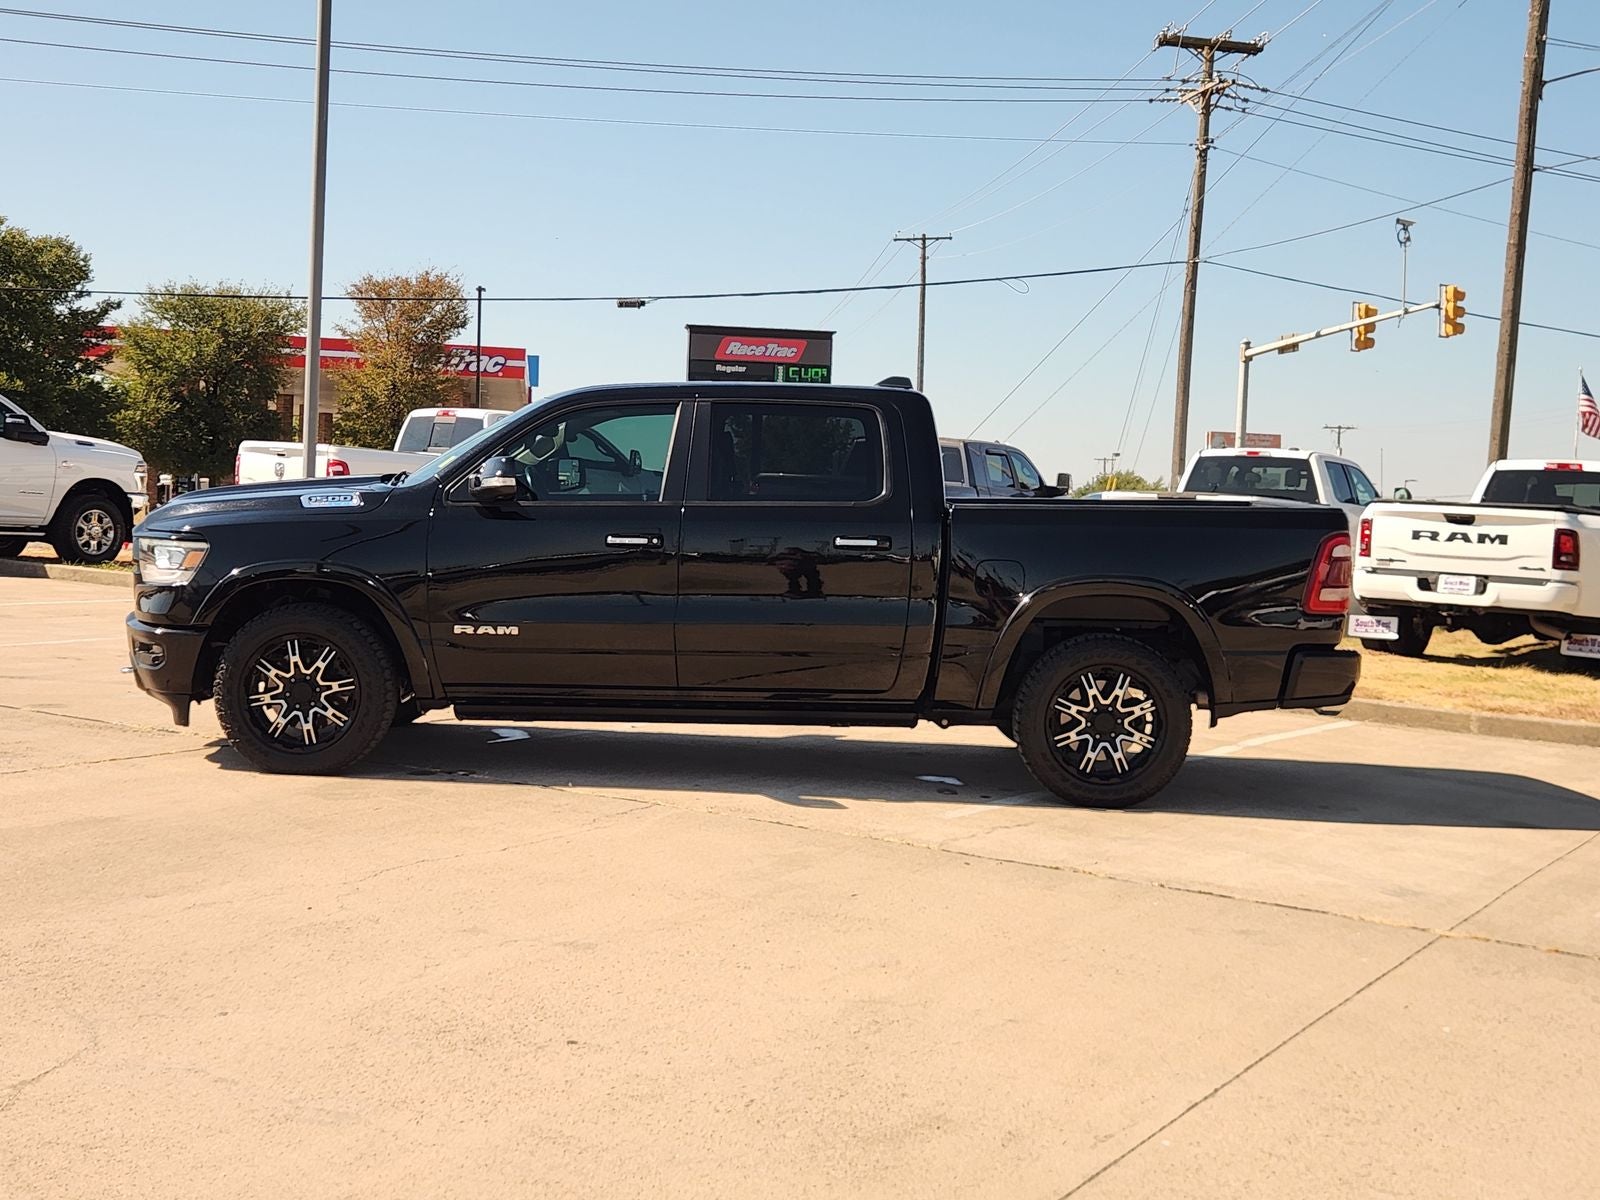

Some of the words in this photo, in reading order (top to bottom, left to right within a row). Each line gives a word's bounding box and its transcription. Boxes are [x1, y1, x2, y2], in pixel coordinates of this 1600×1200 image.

[725, 341, 798, 358] RaceTrac
[715, 364, 747, 373] Regular
[1411, 530, 1509, 545] RAM
[453, 625, 519, 635] RAM
